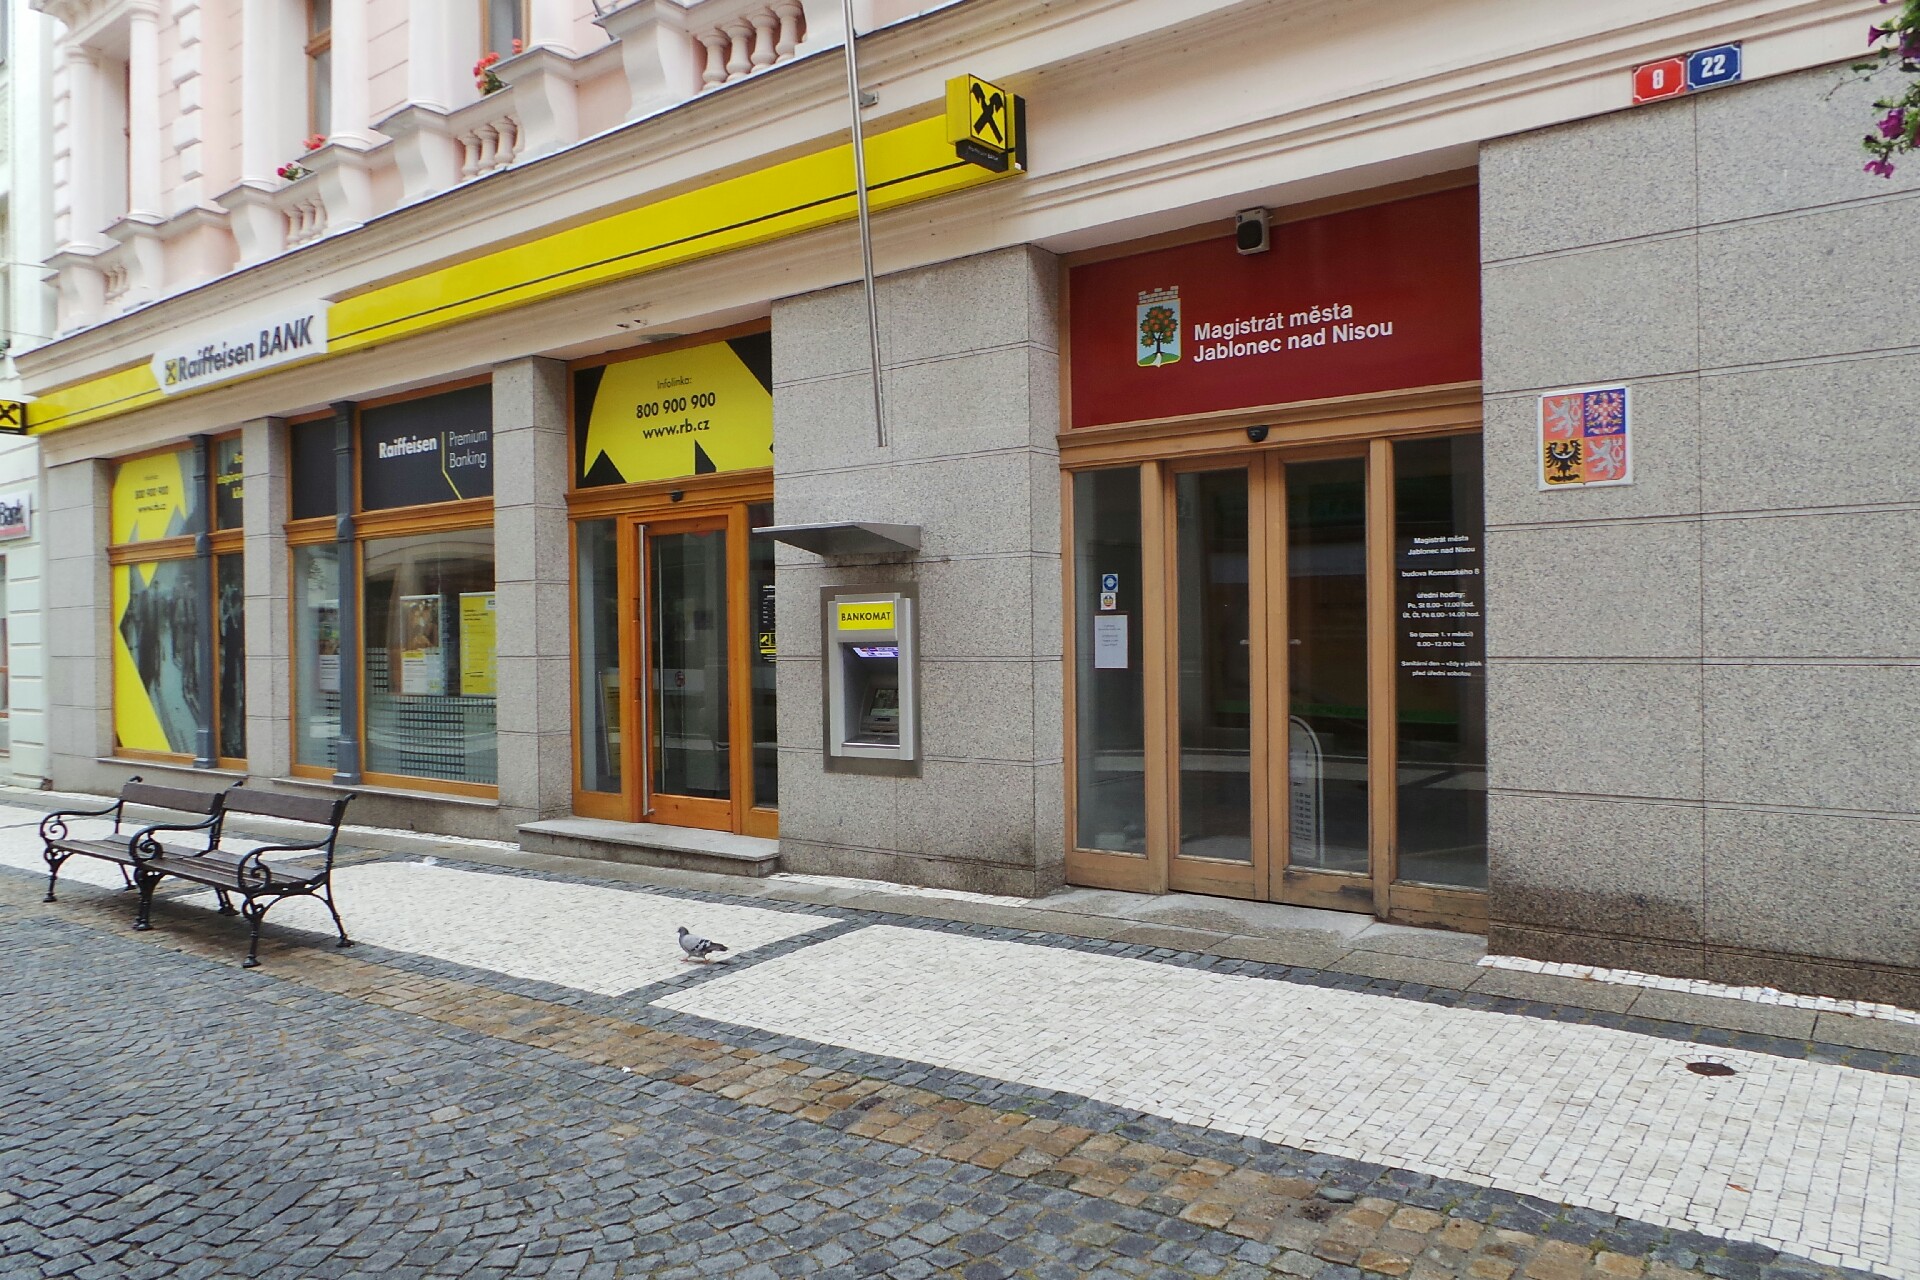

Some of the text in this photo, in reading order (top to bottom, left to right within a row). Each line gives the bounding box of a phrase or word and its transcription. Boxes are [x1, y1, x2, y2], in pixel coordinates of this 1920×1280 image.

[1701, 54, 1726, 78] 22
[1652, 69, 1664, 90] 8
[1194, 302, 1353, 342] Magistrát města
[178, 314, 315, 382] Raiffeisen BANK
[1193, 321, 1394, 363] Jablonec nad Nisou
[657, 375, 693, 390] Infolinka:
[636, 391, 716, 419] 800 900 900
[449, 429, 488, 446] Premium
[642, 418, 710, 439] www.rb.cz
[379, 435, 438, 459] Raiffeisen
[449, 449, 487, 469] Banking
[1413, 534, 1469, 545] Magistrát města
[1407, 548, 1440, 556] Jablonec
[1440, 546, 1454, 554] nad
[1428, 568, 1473, 576] Komenského
[841, 611, 891, 621] BANKOMAT
